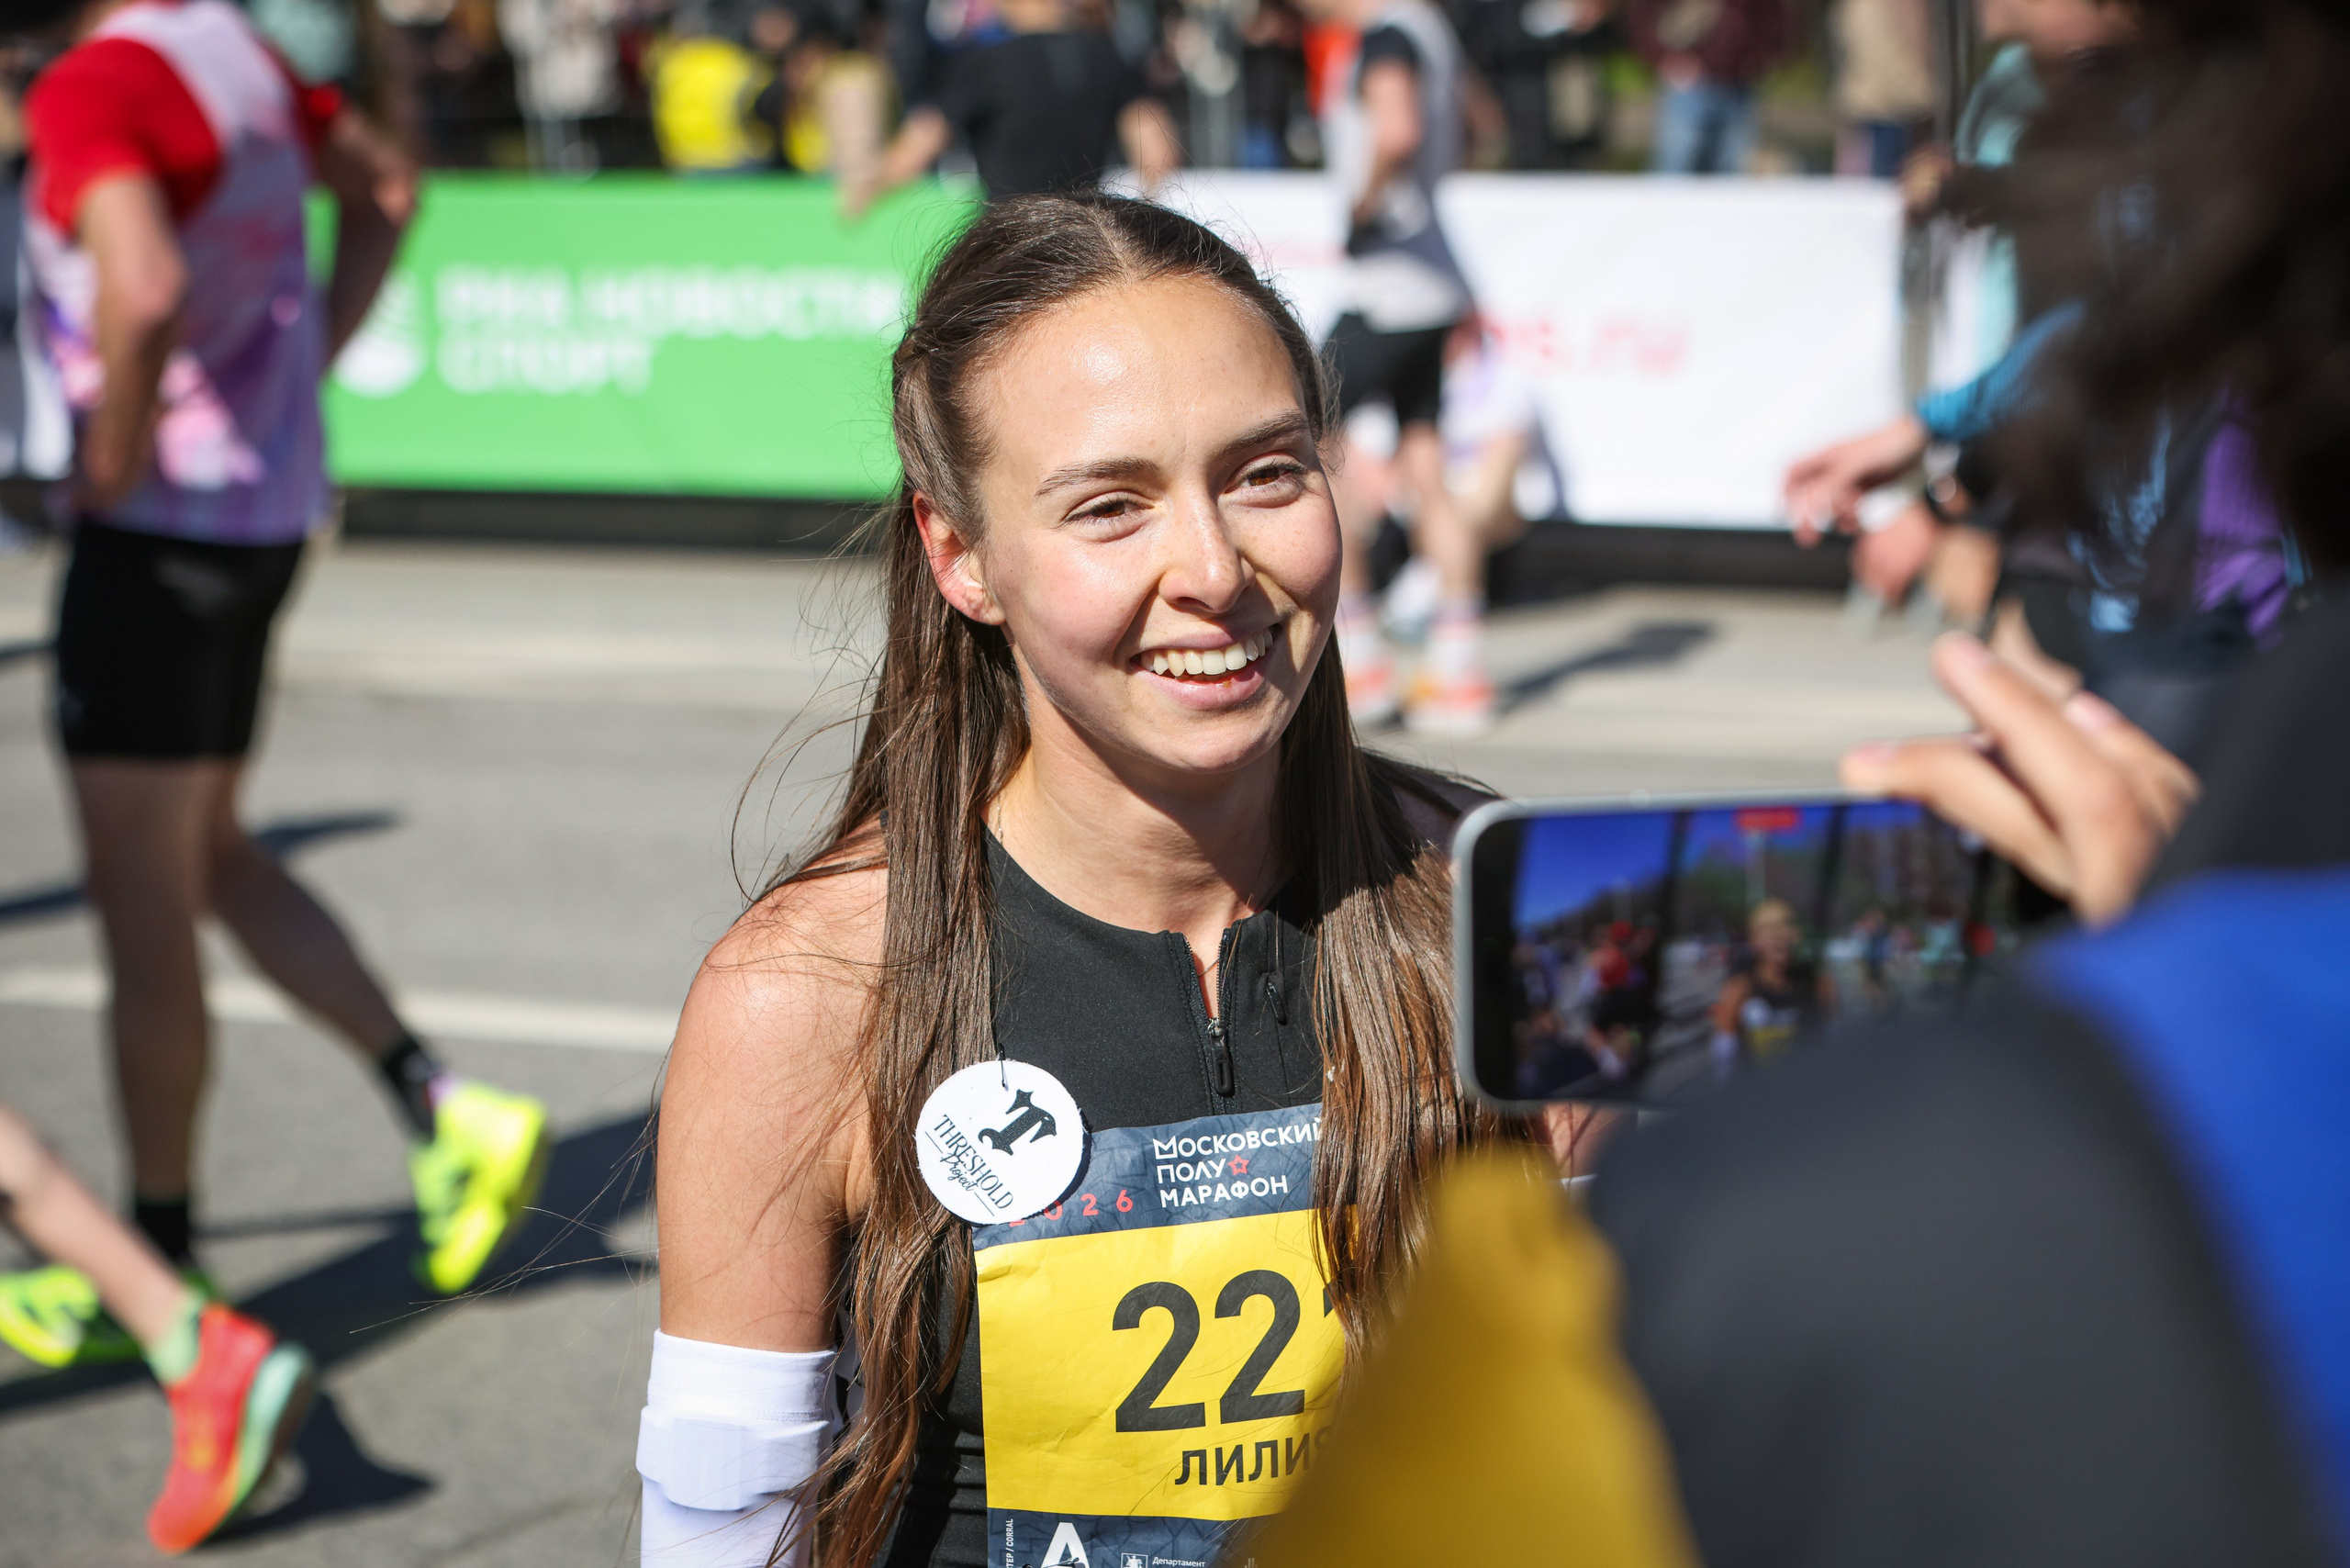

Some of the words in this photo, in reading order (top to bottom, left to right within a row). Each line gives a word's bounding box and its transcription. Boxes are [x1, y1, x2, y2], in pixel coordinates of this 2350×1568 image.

[934, 1113, 1014, 1210] THRESHOLD
[939, 1152, 979, 1192] Project
[1156, 1158, 1226, 1184] ПОЛУ
[1009, 1189, 1134, 1227] 026
[1159, 1174, 1289, 1209] МАРАФОН
[1112, 1269, 1337, 1433] 22
[1005, 1518, 1014, 1547] CORRAL
[1152, 1556, 1206, 1568] Департамент
